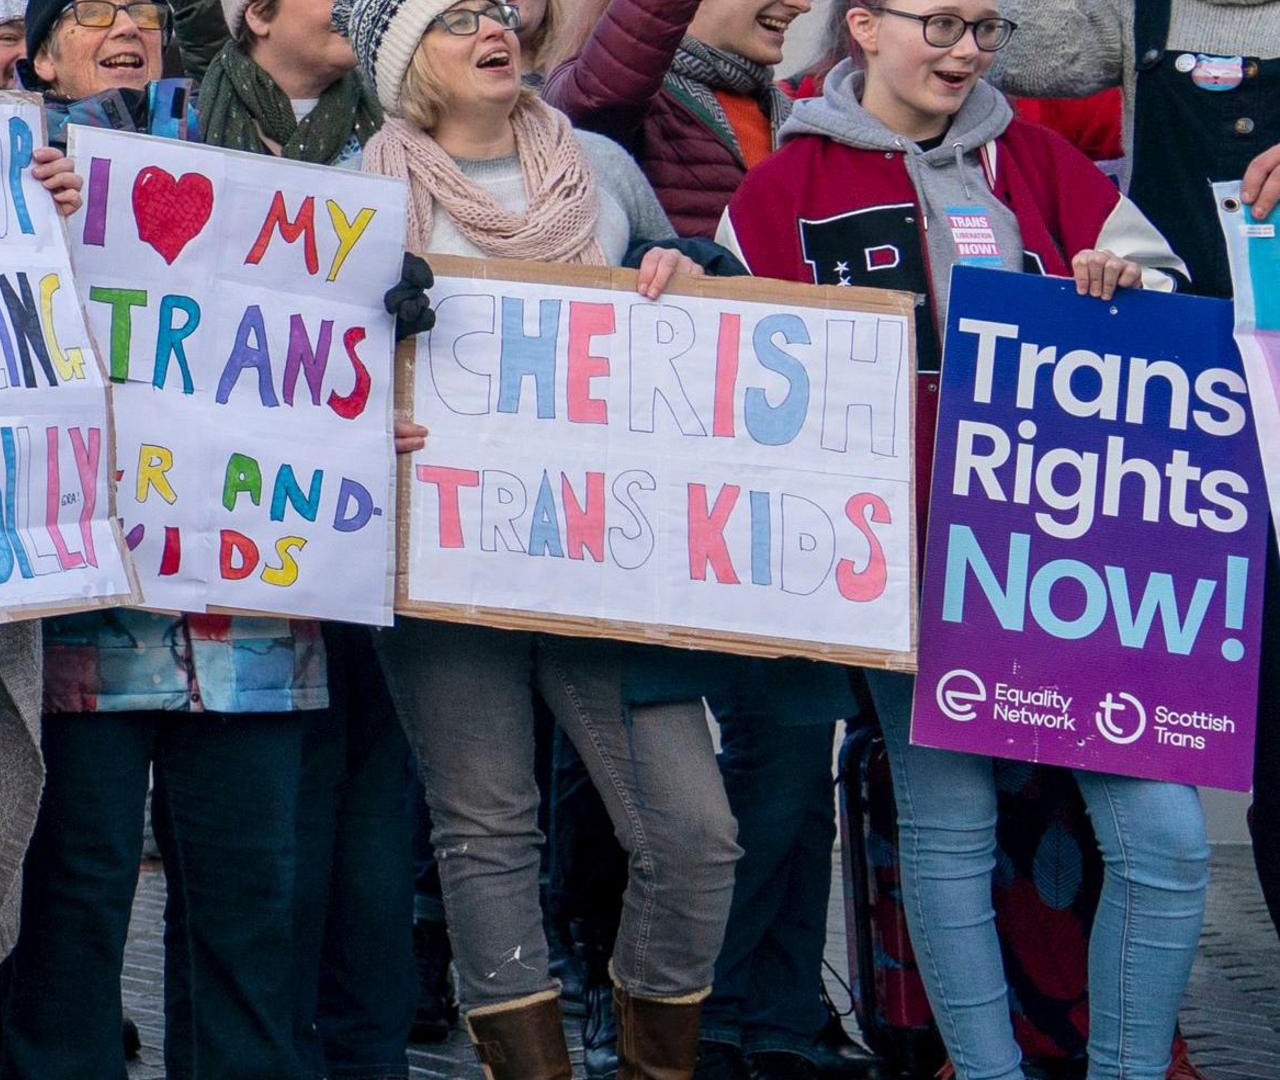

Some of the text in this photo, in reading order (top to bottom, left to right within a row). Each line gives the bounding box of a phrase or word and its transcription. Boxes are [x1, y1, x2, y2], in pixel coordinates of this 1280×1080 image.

[83, 157, 377, 282] I MY
[950, 216, 988, 228] TRANS
[958, 243, 999, 255] NOW!
[89, 286, 372, 420] TRANS
[428, 293, 903, 458] CHERISH
[958, 317, 1248, 437] Trans
[416, 463, 893, 602] TRANS KIDS
[952, 419, 1250, 539] Rights
[942, 524, 1249, 662] Now!
[993, 703, 1076, 731] Network
[994, 683, 1073, 713] Equality
[1153, 726, 1205, 749] Trans
[1154, 706, 1235, 733] Scottish
